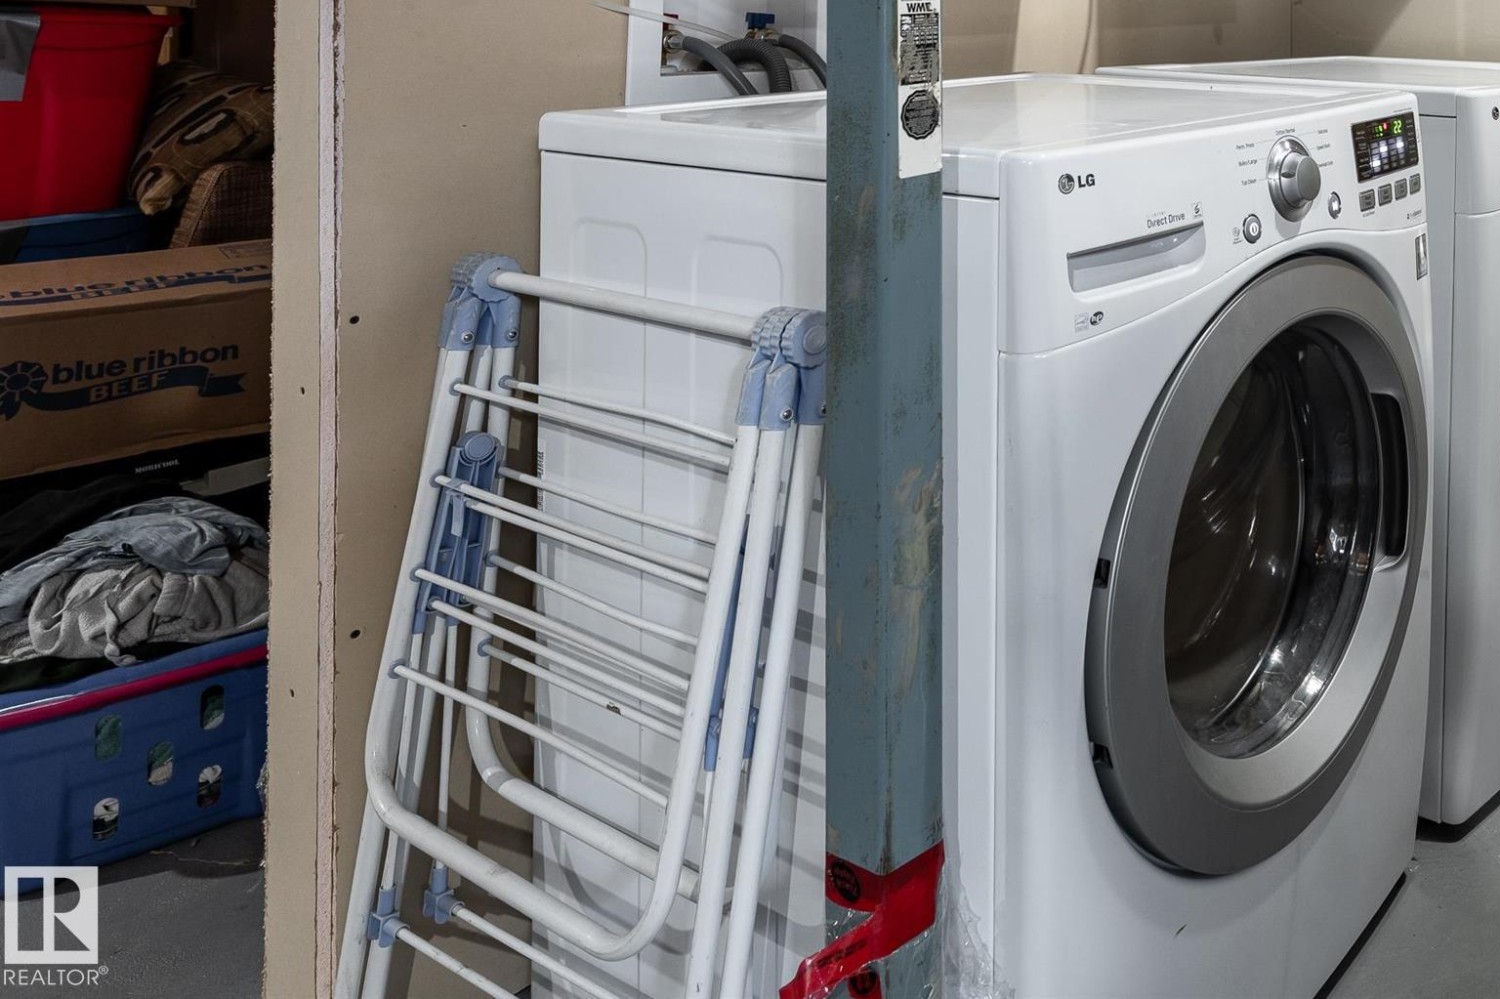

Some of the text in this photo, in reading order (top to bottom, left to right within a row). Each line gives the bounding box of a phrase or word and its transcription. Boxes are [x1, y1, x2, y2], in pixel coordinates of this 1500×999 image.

[1393, 120, 1402, 134] 22
[1078, 173, 1096, 188] LG
[1147, 216, 1168, 229] Direct
[1168, 212, 1186, 224] Drive
[52, 344, 239, 385] blue ribbon
[89, 369, 170, 403] BEEF
